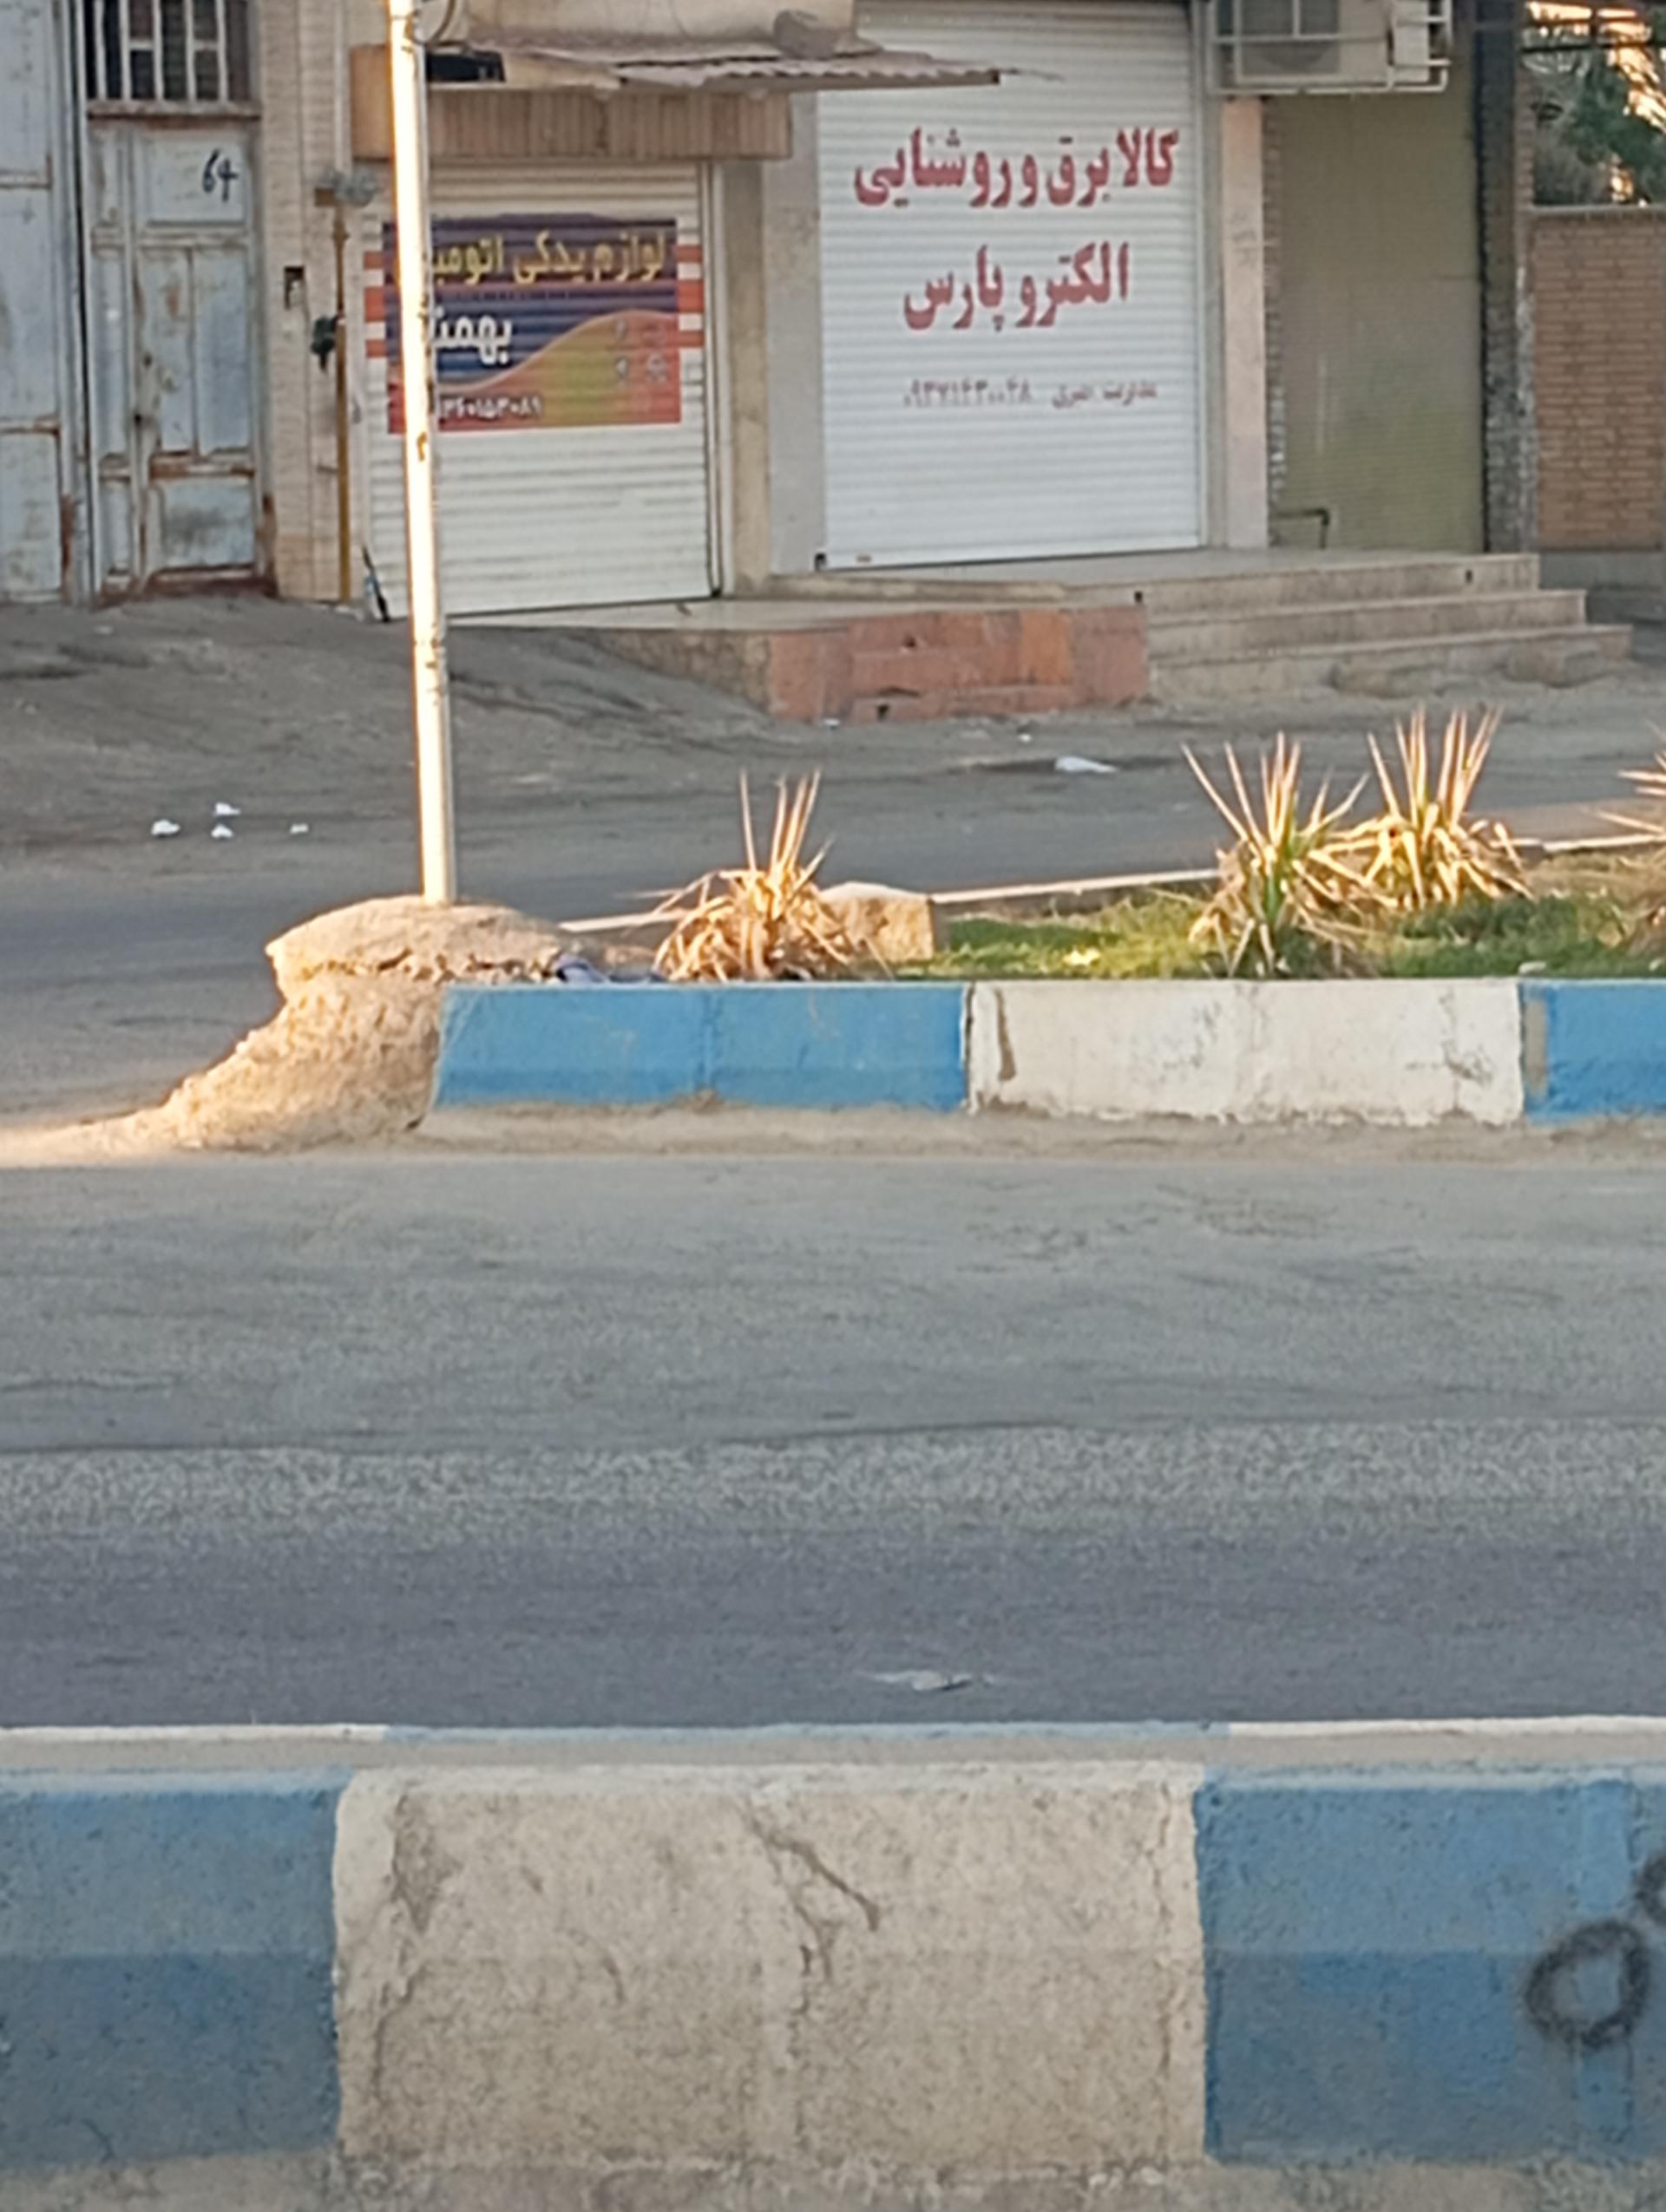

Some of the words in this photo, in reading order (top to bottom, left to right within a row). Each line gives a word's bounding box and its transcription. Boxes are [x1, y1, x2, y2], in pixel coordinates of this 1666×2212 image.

[854, 127, 1013, 207] روشنایی
[1046, 135, 1109, 207] برق
[1116, 127, 1178, 187] کالا
[433, 234, 504, 285] اتومب
[513, 229, 587, 285] یدکی
[594, 232, 666, 284] لوازم
[903, 243, 1005, 332] پارس
[1015, 241, 1129, 328] الکترو
